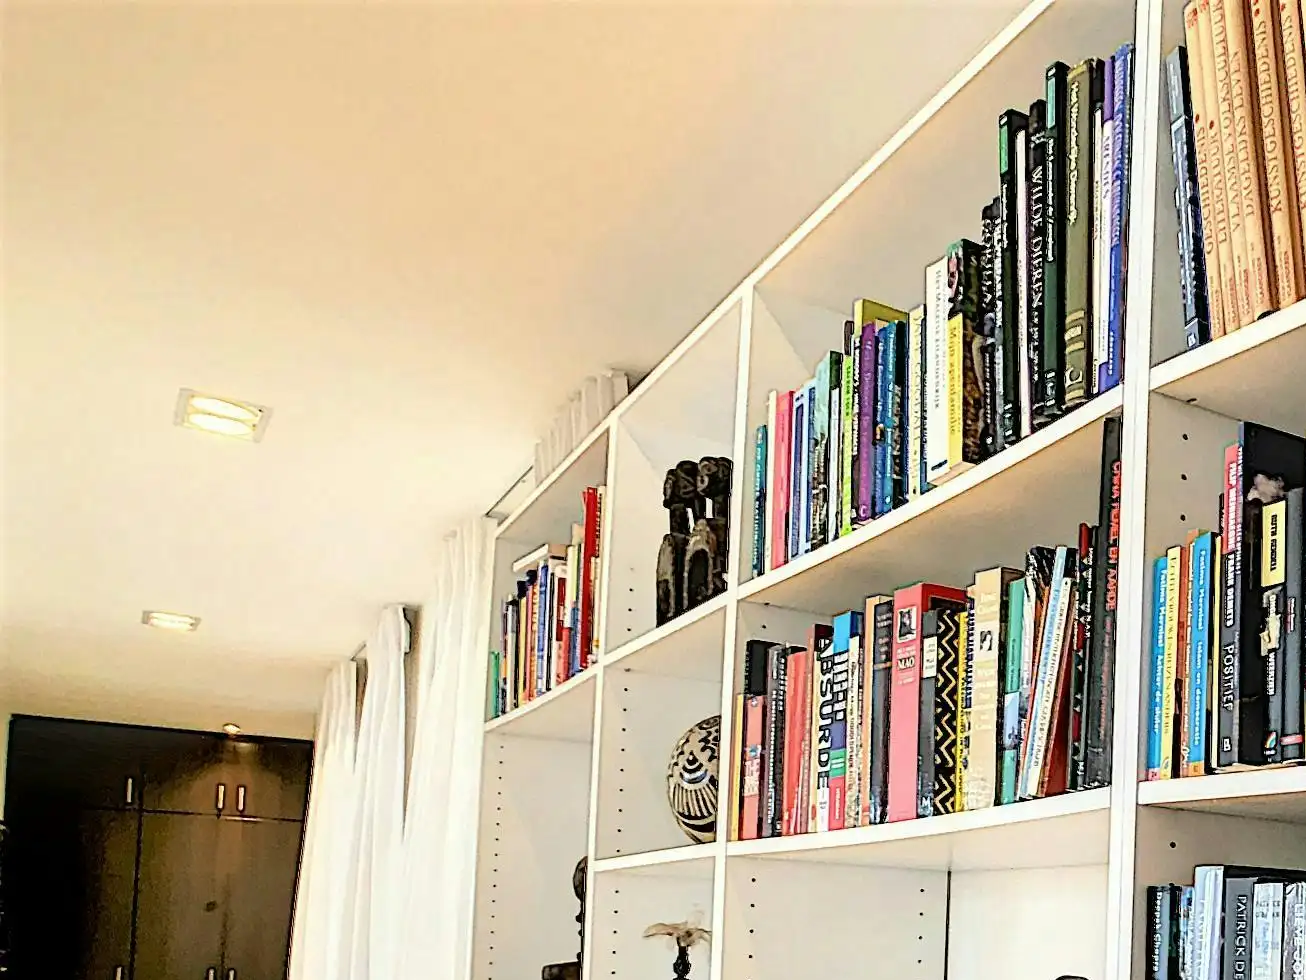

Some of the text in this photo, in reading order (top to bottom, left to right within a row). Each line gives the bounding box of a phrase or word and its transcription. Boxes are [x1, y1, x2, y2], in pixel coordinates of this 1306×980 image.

[1254, 20, 1282, 213] KUNSTGESCHIEDENIS
[898, 658, 915, 669] MAO
[1233, 893, 1249, 956] PATRICK
[1233, 961, 1246, 980] DE
